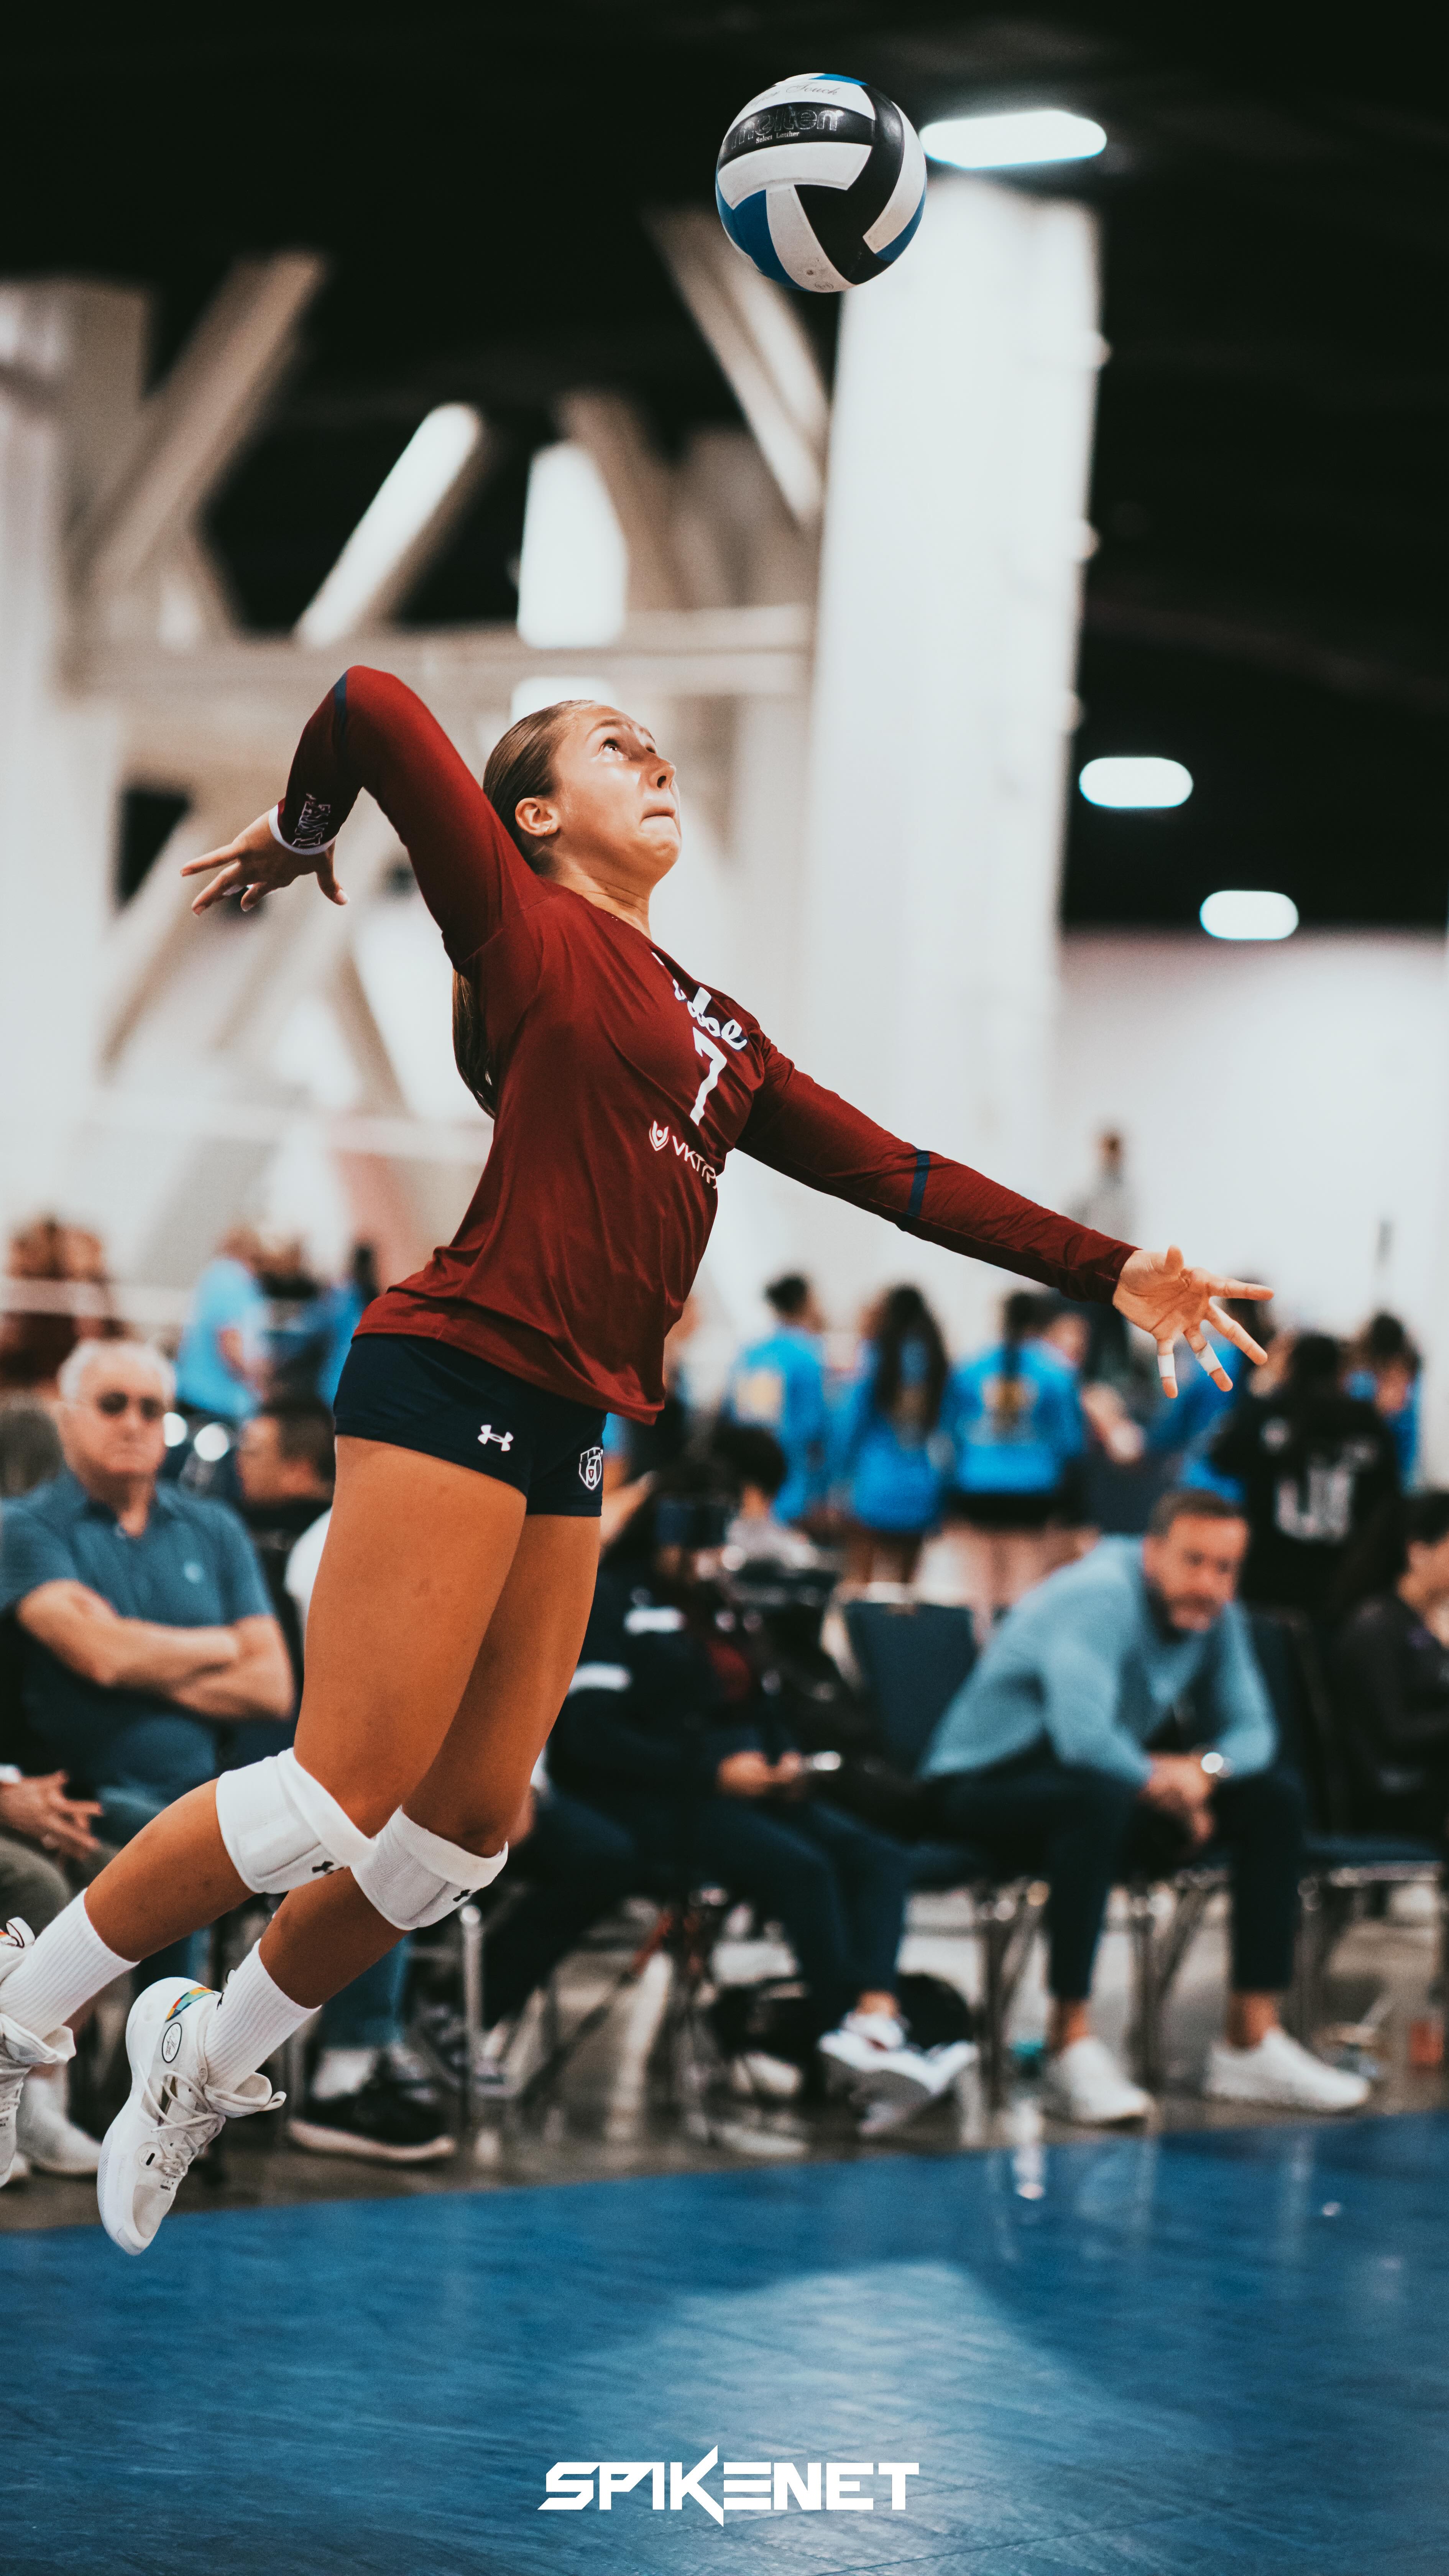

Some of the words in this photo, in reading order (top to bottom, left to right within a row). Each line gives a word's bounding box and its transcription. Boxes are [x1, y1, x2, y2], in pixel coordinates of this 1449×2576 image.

[786, 82, 841, 95] Touch
[731, 107, 840, 149] molten
[756, 135, 772, 144] Select
[776, 131, 800, 139] Leather
[690, 1026, 726, 1126] 7
[672, 1135, 717, 1189] VKTR
